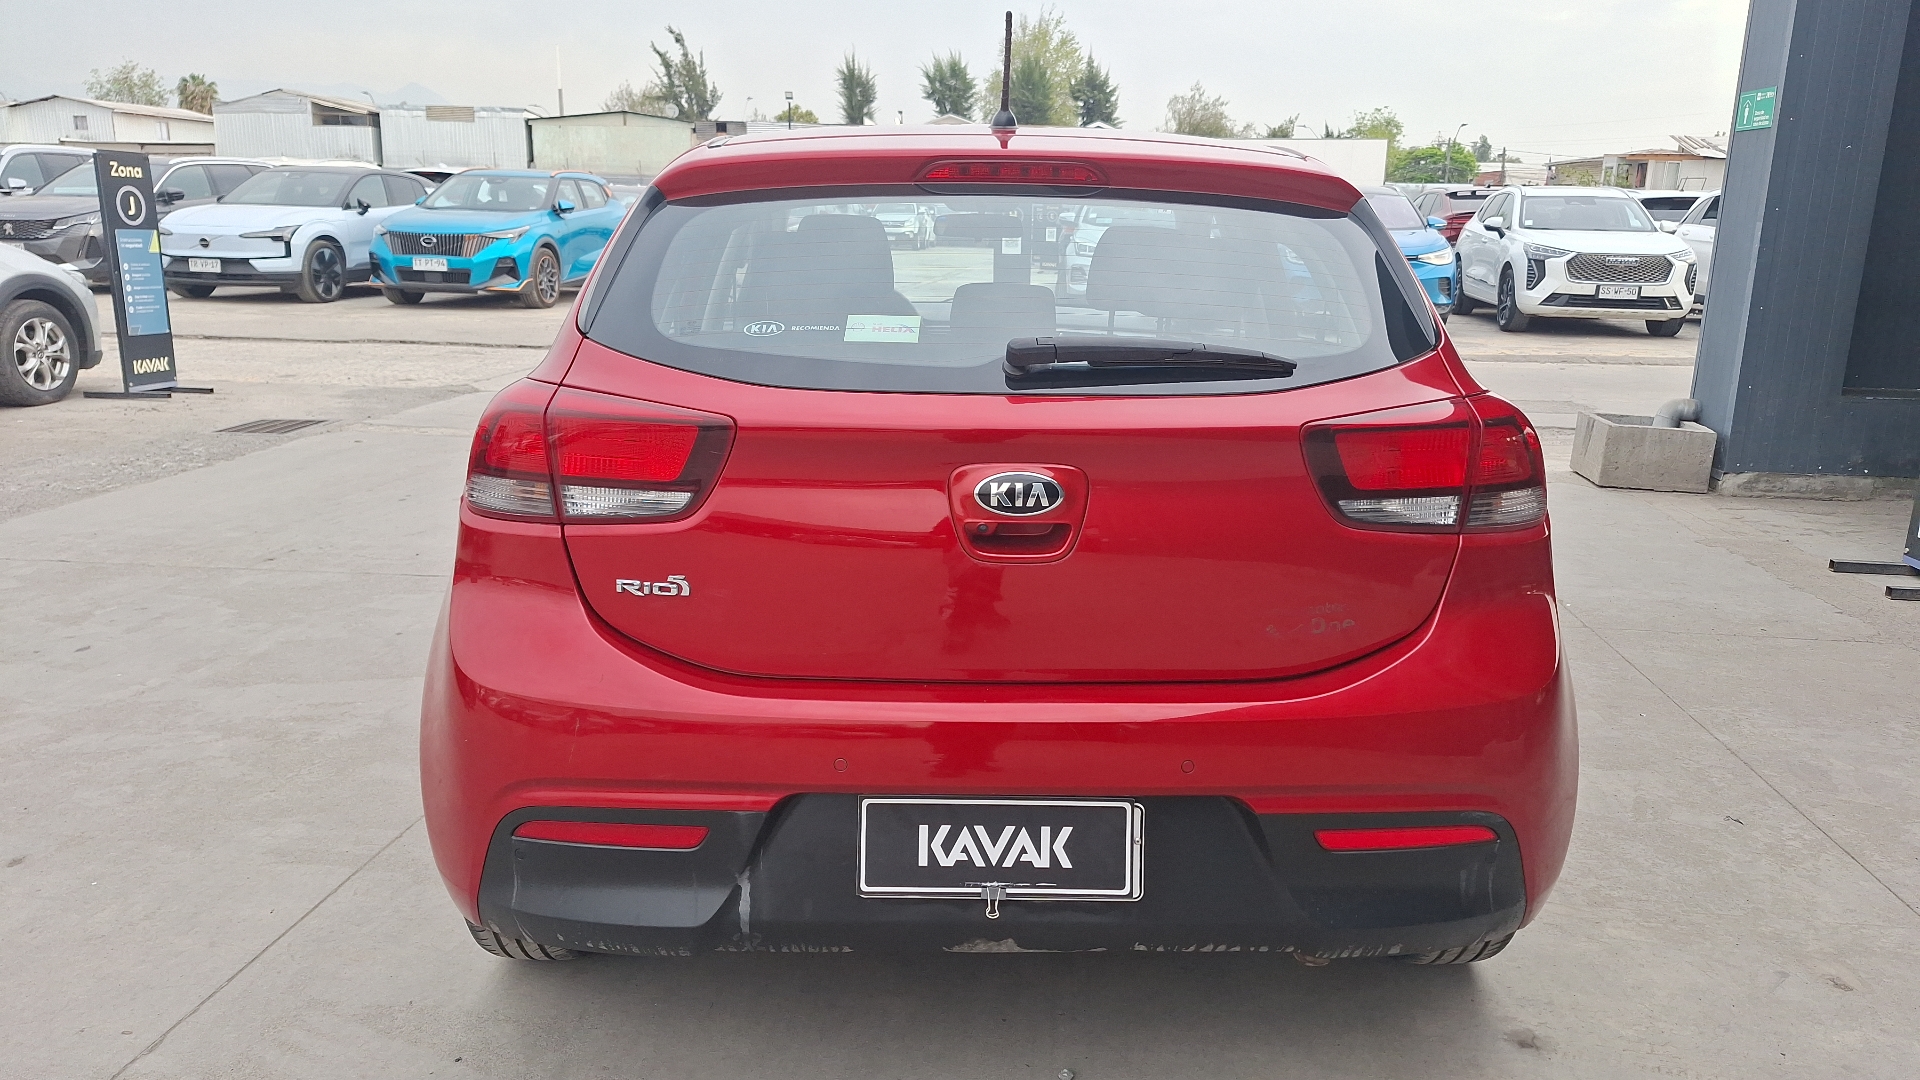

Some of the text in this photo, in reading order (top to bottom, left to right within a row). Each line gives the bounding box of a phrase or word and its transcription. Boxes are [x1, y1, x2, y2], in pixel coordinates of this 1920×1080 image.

[109, 160, 143, 179] Zona
[127, 195, 136, 216] J
[750, 324, 778, 334] KIA
[132, 356, 170, 375] KAVAK
[989, 482, 1050, 507] KIA
[917, 824, 1074, 868] KAVAK
